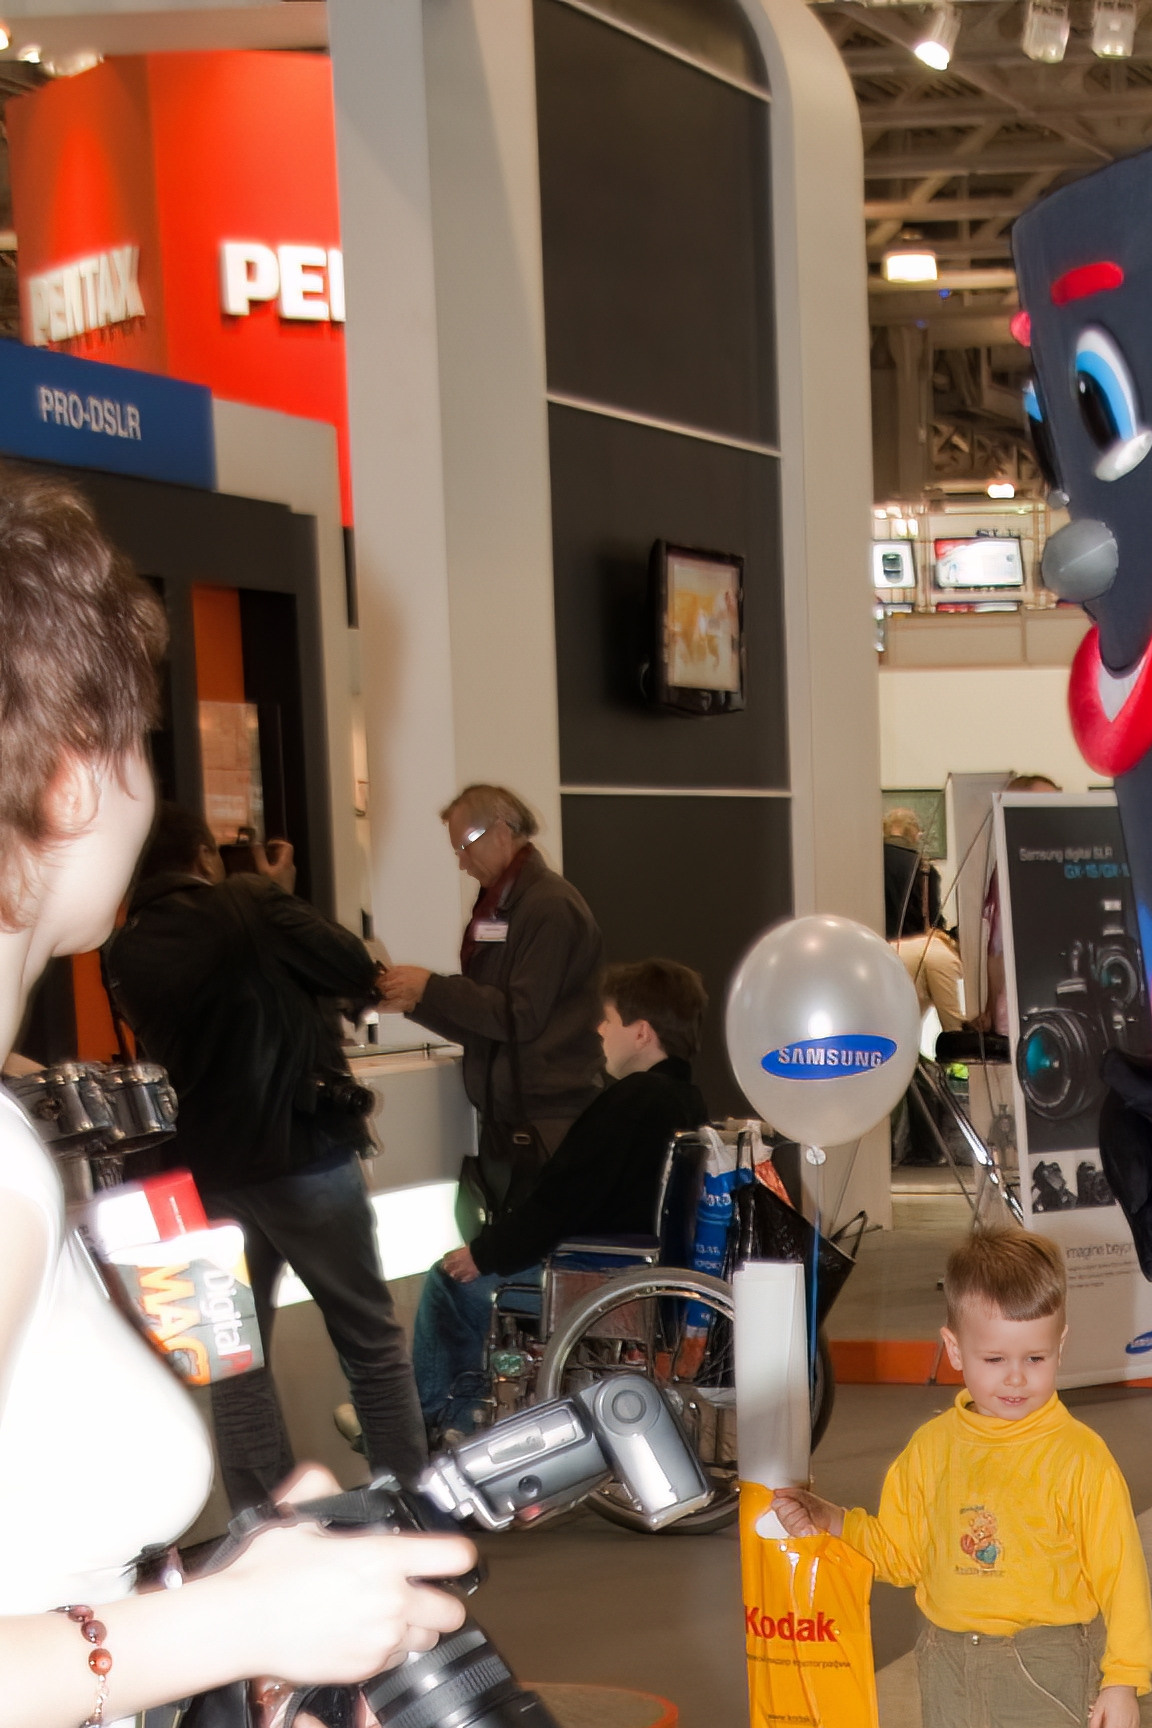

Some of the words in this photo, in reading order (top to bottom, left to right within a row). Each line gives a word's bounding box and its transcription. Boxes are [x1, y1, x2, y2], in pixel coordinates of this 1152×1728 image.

[29, 245, 146, 346] PENTAX
[38, 385, 142, 440] PRO-DSLR
[778, 1048, 883, 1067] SAMSUNG
[745, 1605, 837, 1643] Kodak
